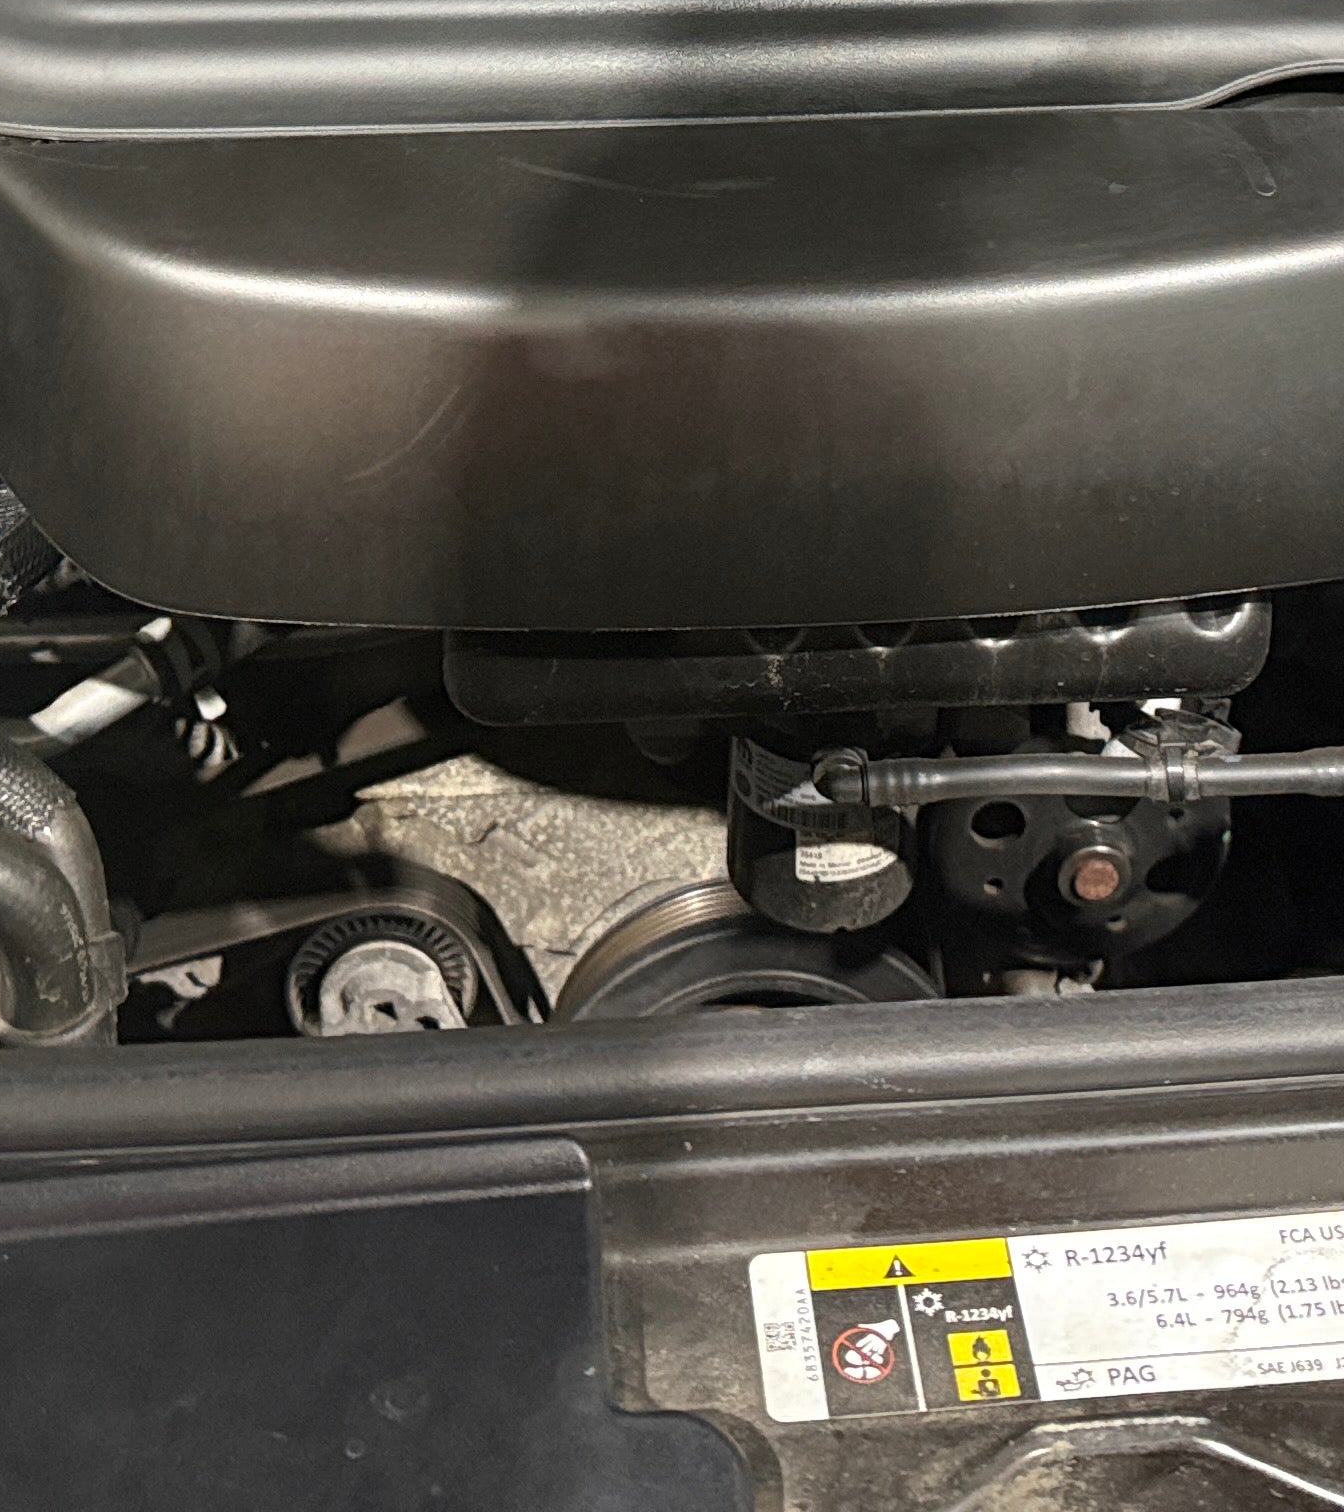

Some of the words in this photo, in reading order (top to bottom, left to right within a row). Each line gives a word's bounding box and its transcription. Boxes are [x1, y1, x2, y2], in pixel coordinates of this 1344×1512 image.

[1279, 1228, 1316, 1244] FCA
[1320, 1225, 1344, 1240] US
[1065, 1241, 1168, 1267] R-1234yf
[1108, 1288, 1188, 1307] 3.6/5.7L
[1213, 1283, 1261, 1301] 964g
[1270, 1277, 1319, 1298] (2.13
[944, 1305, 1014, 1323] R-1234yf
[1156, 1313, 1198, 1328] 6.4L
[1221, 1307, 1269, 1325] 794g
[1278, 1303, 1326, 1324] (1.75
[1107, 1364, 1157, 1386] PAG
[1256, 1361, 1285, 1375] SAE
[1290, 1358, 1323, 1374] J639
